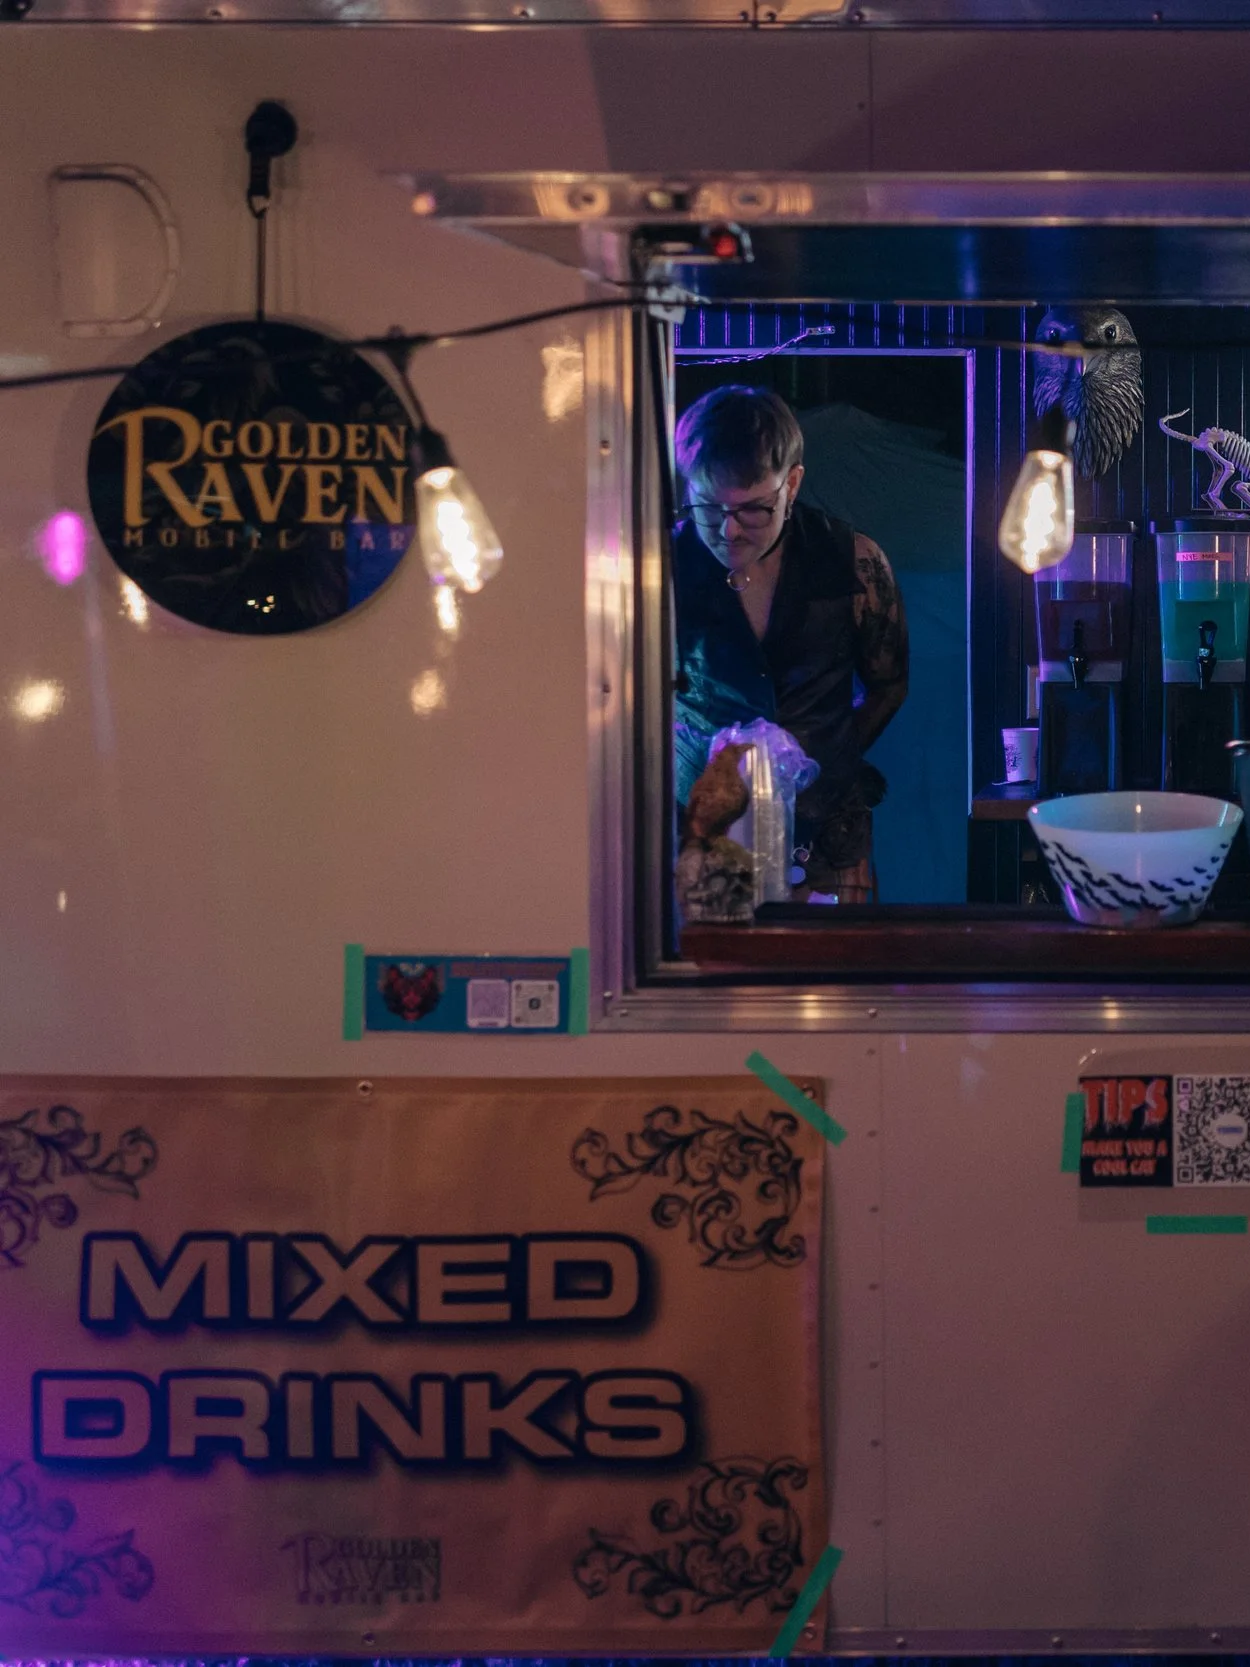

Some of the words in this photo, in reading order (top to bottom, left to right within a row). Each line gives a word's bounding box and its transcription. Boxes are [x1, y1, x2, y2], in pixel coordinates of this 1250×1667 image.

[95, 406, 409, 527] RAVEN
[199, 420, 408, 461] GOLDEN
[328, 529, 408, 550] BAR
[1080, 1079, 1170, 1133] TIPS
[79, 1231, 648, 1328] MIXED
[32, 1369, 692, 1466] DRINKS
